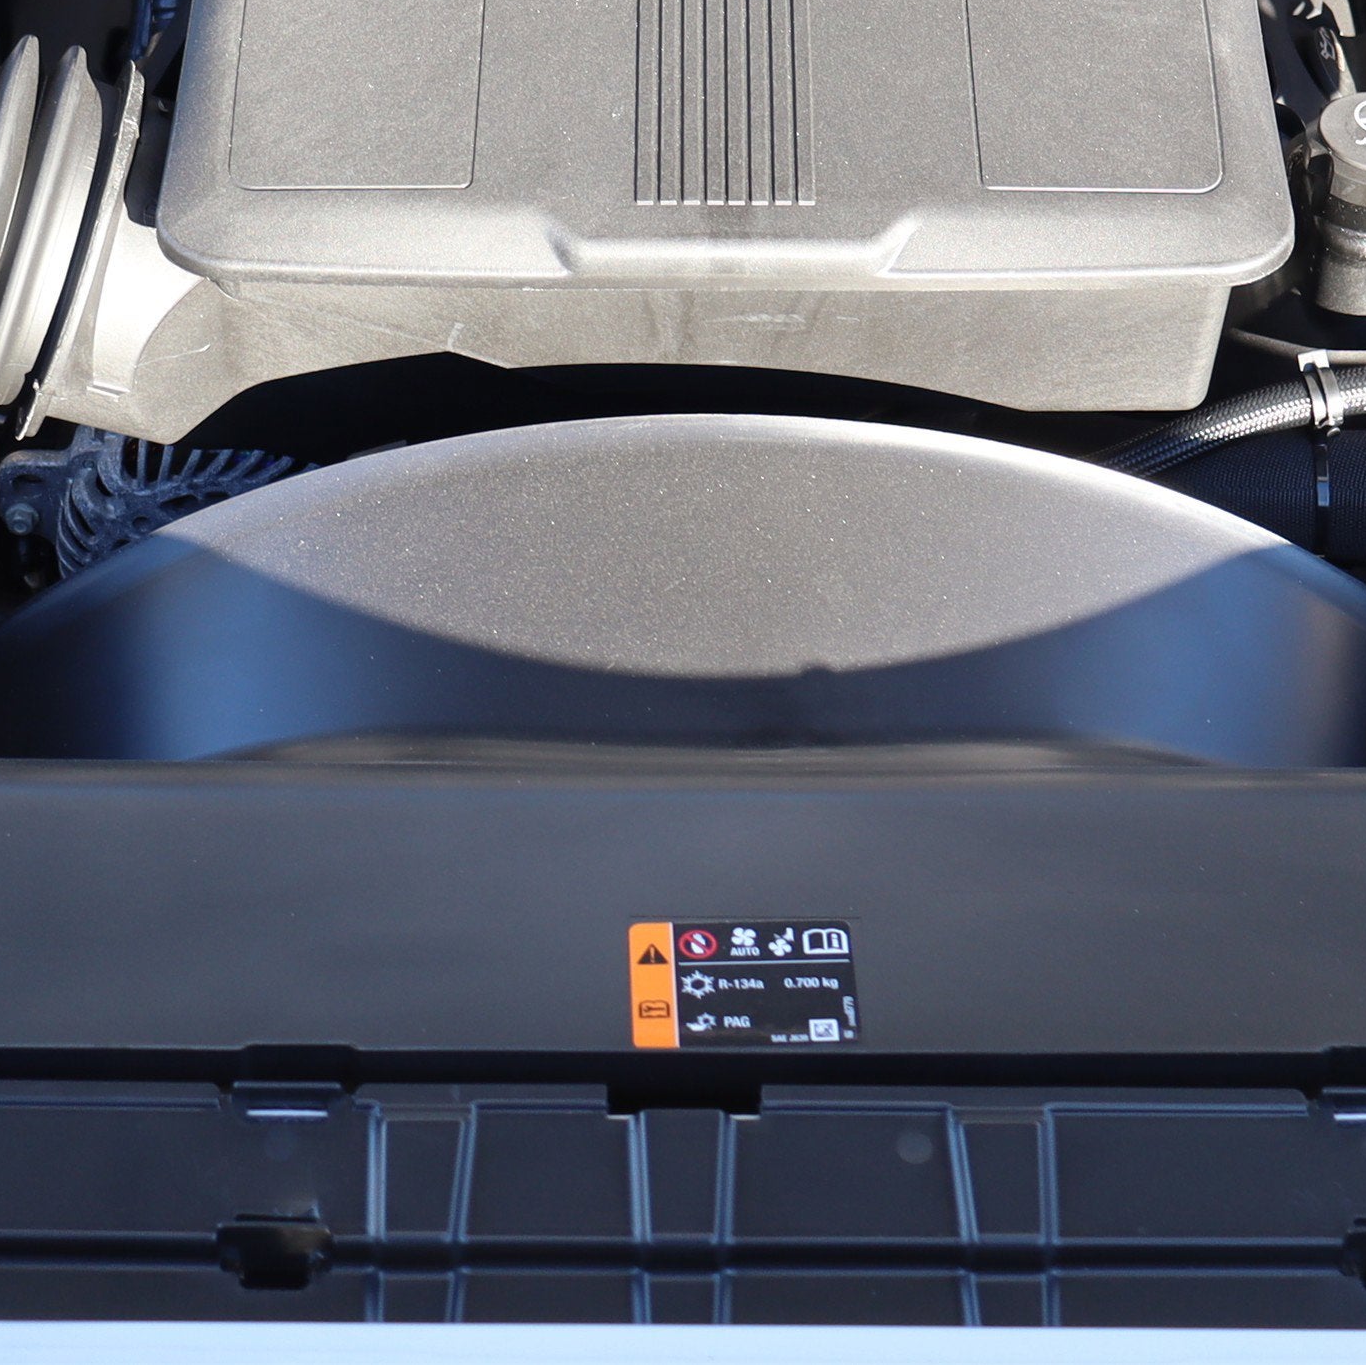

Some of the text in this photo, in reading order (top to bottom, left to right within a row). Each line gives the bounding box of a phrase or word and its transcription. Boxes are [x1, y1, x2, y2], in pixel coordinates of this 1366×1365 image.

[730, 946, 761, 957] AUTO
[718, 977, 839, 990] R-134a 0.700 kg
[723, 1015, 751, 1028] PAG
